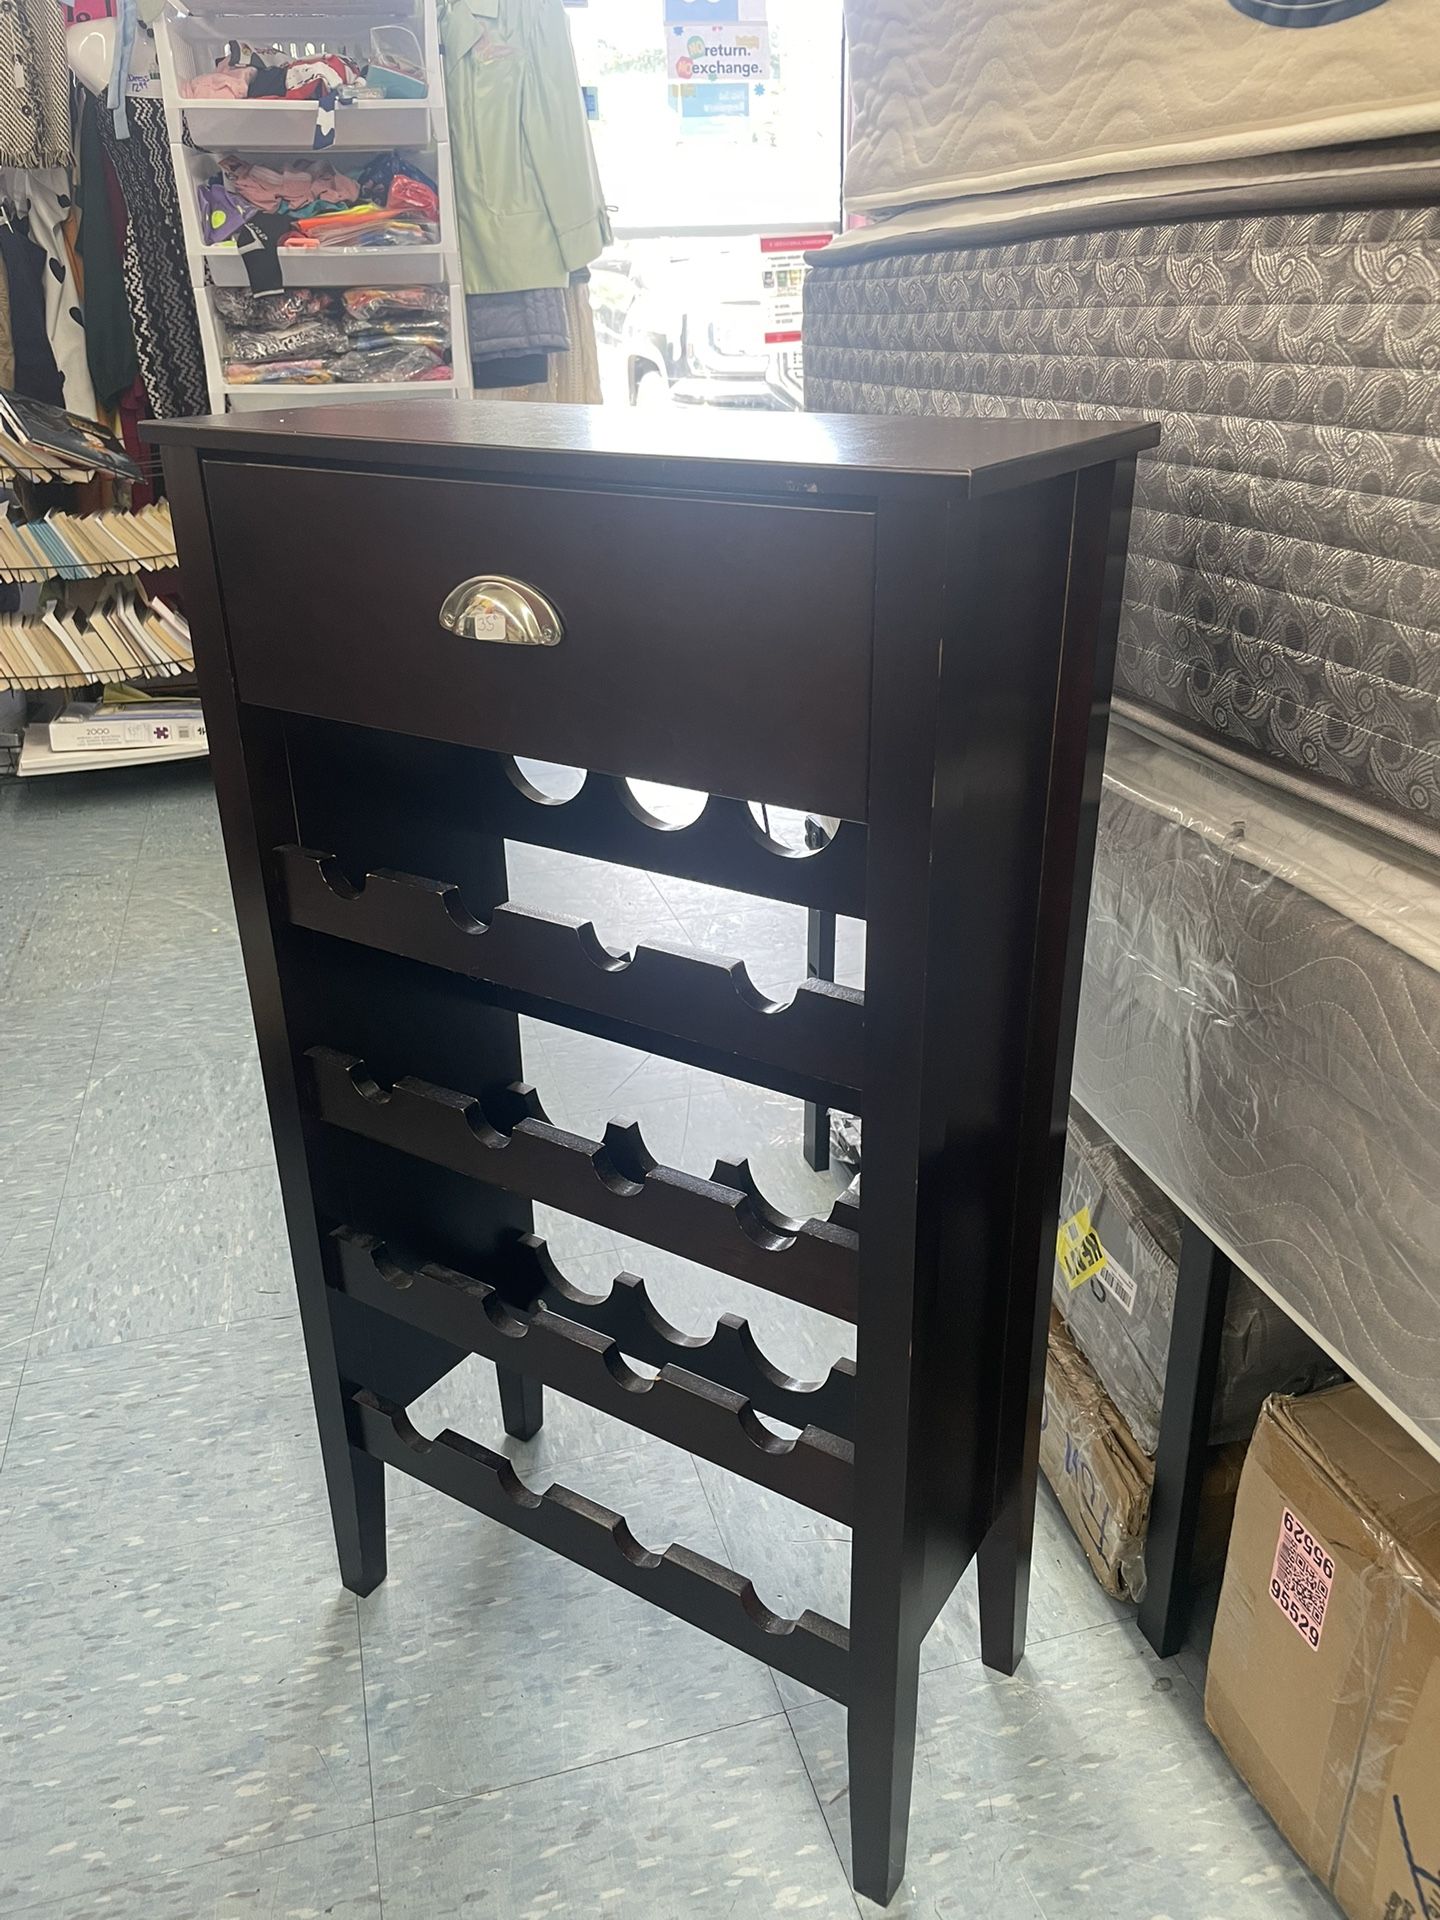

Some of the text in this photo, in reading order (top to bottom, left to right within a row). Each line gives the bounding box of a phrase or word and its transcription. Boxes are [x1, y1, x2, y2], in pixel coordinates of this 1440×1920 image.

[704, 44, 751, 56] return.
[692, 60, 763, 78] exchange.
[86, 727, 110, 735] 2000
[1283, 1511, 1334, 1580] 95529
[1271, 1578, 1320, 1647] 95529
